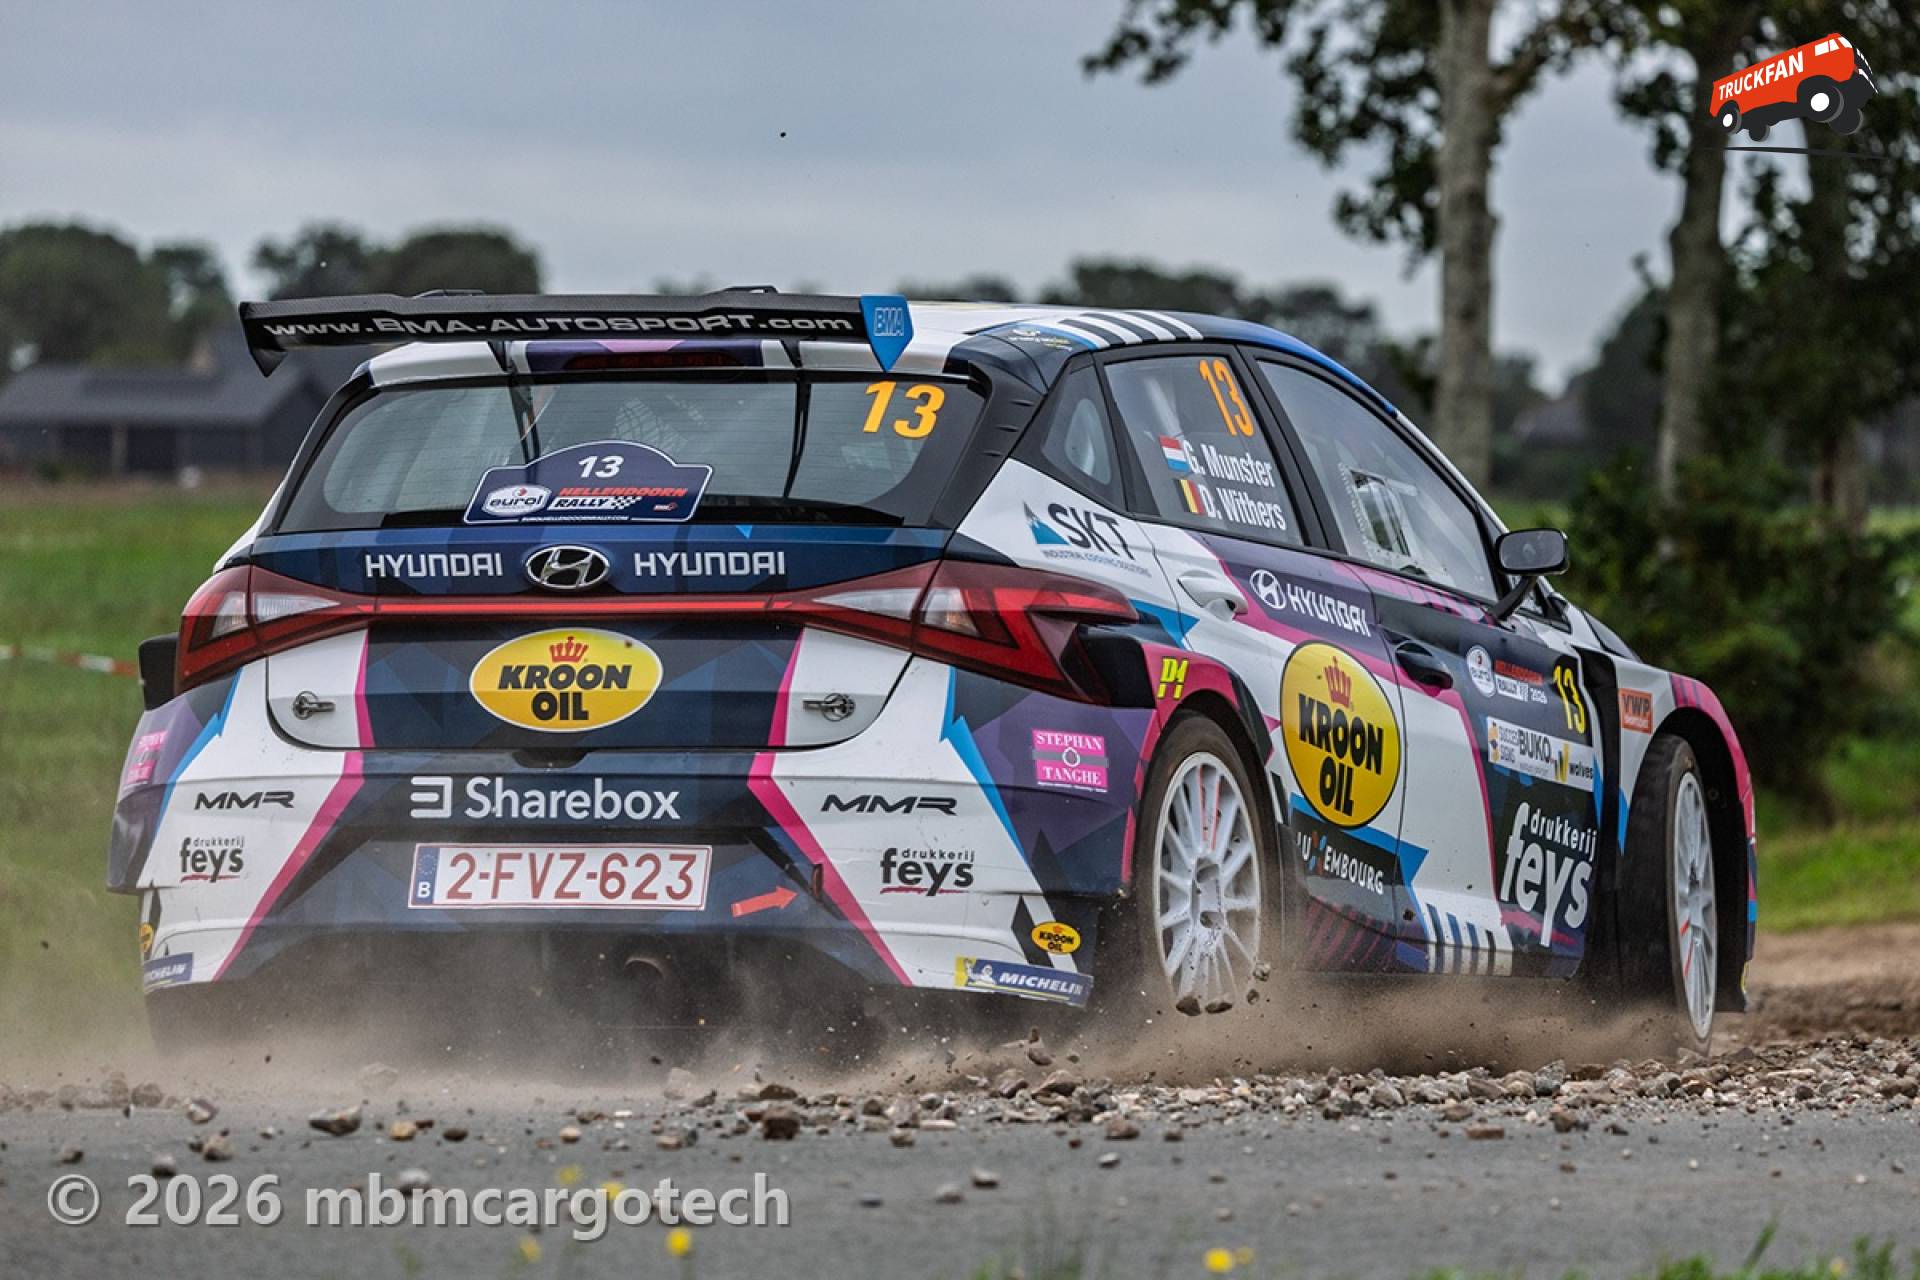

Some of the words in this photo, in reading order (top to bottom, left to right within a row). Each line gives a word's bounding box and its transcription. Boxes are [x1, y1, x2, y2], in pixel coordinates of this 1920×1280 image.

[263, 313, 854, 336] www.BMA-AUTOSPORT.com
[874, 307, 905, 336] BMA
[862, 380, 946, 439] 13
[1199, 358, 1254, 437] 13
[577, 455, 625, 478] 13
[1182, 439, 1206, 475] G.
[1200, 442, 1276, 488] Munster
[554, 497, 610, 509] RALLY
[559, 487, 689, 497] HELLENDOORN
[1198, 483, 1223, 520] D.
[1215, 486, 1287, 531] Withers
[1047, 502, 1136, 561] SKT
[364, 553, 504, 578] HYUNDAI
[633, 551, 786, 577] HYUNDAI
[1286, 582, 1371, 637] HYUNDAI
[497, 664, 633, 690] KROON
[531, 691, 590, 721] OIL
[1553, 664, 1586, 734] 13
[1036, 732, 1103, 750] STEPHAN
[1297, 692, 1384, 776] KROON
[1518, 728, 1551, 763] BUKO
[1042, 765, 1102, 785] TANGHE
[1319, 756, 1355, 817] OIL
[194, 791, 296, 810] MMR
[464, 775, 682, 821] Sharebox
[820, 793, 958, 816] MMR
[193, 836, 246, 849] drukkerij
[1530, 807, 1599, 863] drukkerij
[179, 837, 245, 883] feys
[901, 848, 976, 864] drukkerij
[446, 852, 698, 901] 2-FVZ-623
[880, 848, 975, 897] feys
[1500, 802, 1594, 948] feys
[416, 882, 431, 899] B
[1039, 930, 1075, 945] KROON
[1047, 941, 1063, 952] OIL
[999, 971, 1084, 995] MICHELIN
